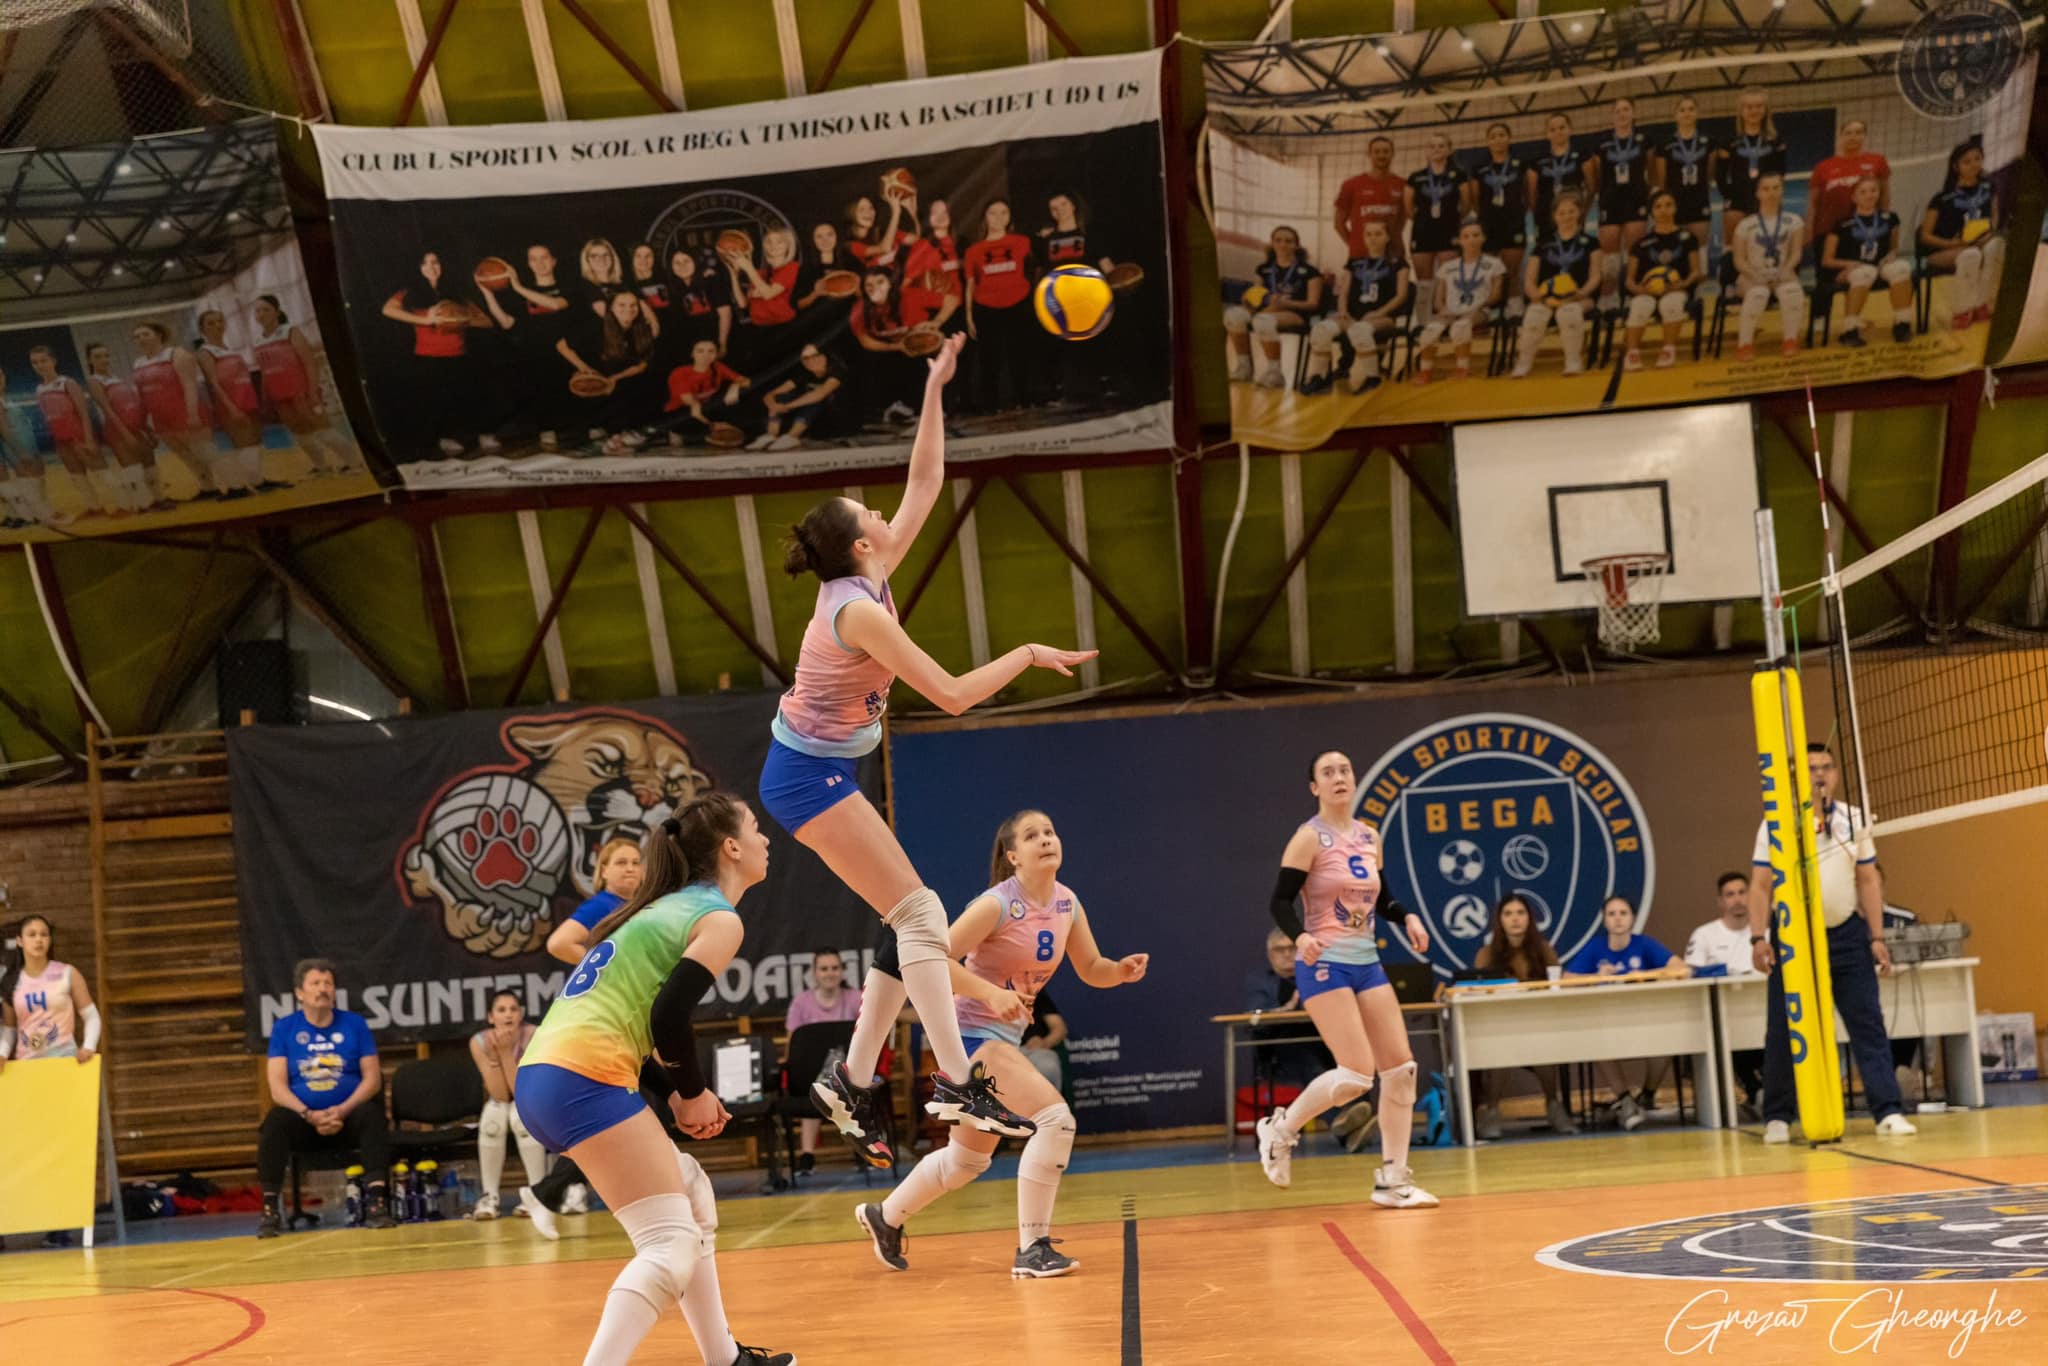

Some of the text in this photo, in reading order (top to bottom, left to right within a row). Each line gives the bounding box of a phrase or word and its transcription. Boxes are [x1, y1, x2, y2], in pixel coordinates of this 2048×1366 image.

[342, 151, 444, 172] CLUBUL
[449, 144, 561, 168] SPORTIV
[570, 134, 676, 161] SCOLAR
[682, 126, 750, 152] BEGA
[758, 107, 912, 145] TIMISOARA
[918, 88, 1039, 128] BASCHET
[1413, 726, 1551, 769] SPORTIV
[1558, 749, 1639, 854] SCOLAR
[1425, 795, 1554, 834] BEGA
[1347, 855, 1369, 879] 6
[1758, 752, 1797, 966] MIKASA
[563, 939, 617, 1000] 8
[1036, 930, 1055, 962] 8
[25, 991, 48, 1014] 14
